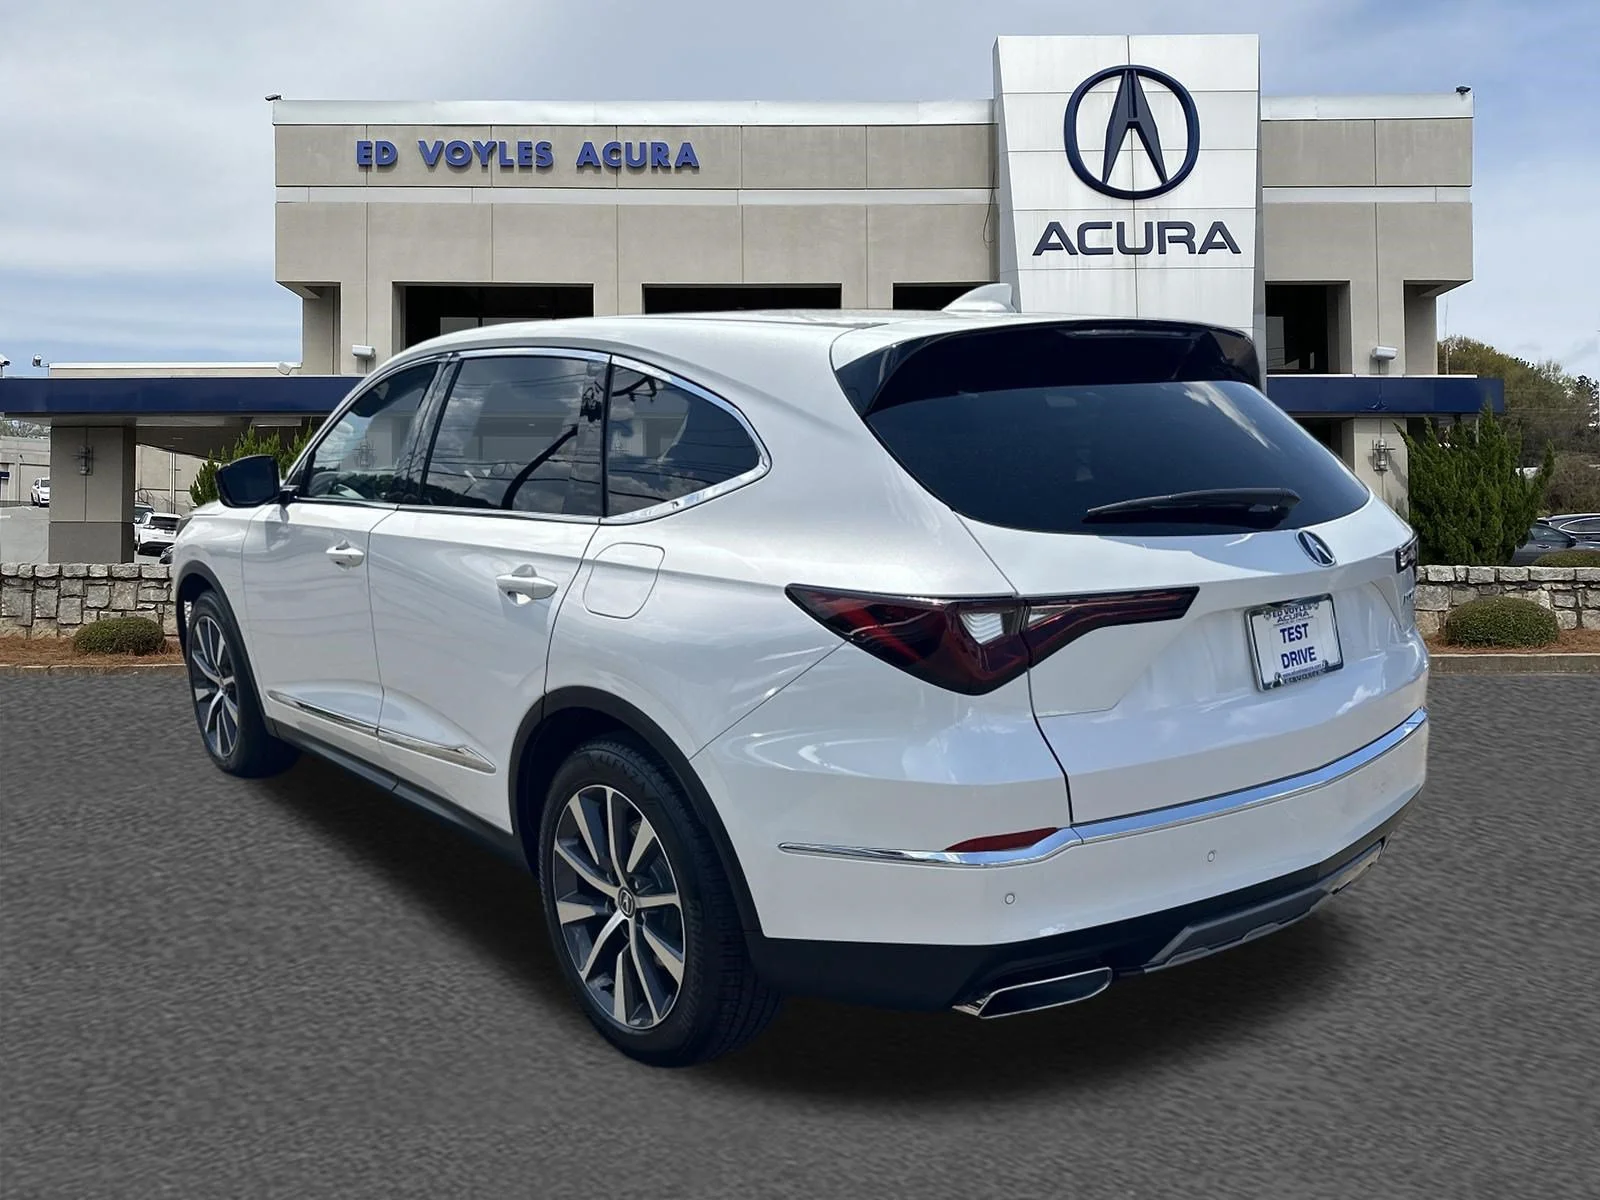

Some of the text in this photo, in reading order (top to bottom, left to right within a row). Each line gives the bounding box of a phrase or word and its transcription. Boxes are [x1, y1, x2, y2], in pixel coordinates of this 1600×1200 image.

[356, 140, 700, 168] ED VOYLES ACURA
[1032, 221, 1242, 255] ACURA
[1277, 610, 1310, 622] ACURA
[1280, 623, 1309, 643] TEST
[1281, 646, 1317, 669] DRIVE
